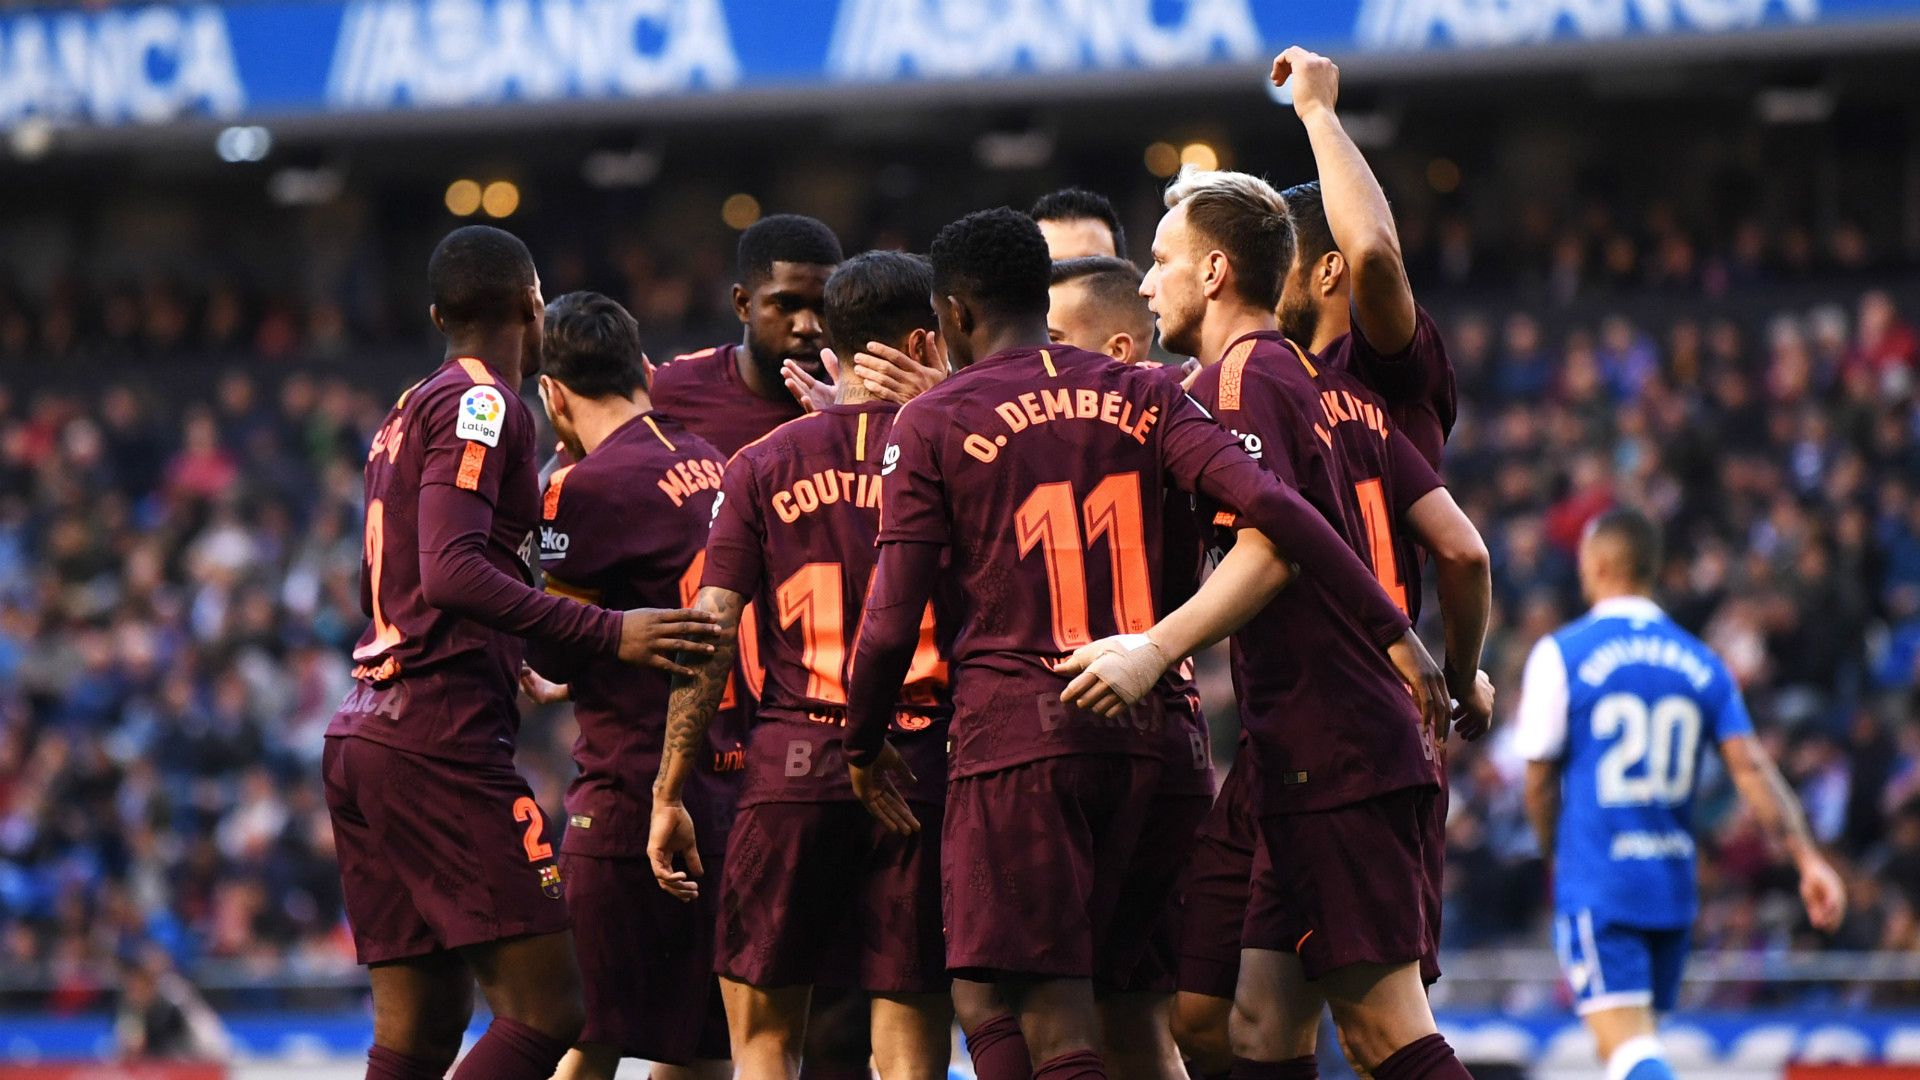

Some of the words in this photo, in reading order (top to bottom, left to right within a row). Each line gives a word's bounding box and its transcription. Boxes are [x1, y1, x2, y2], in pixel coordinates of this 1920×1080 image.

[462, 421, 496, 438] LaLiga
[963, 433, 1008, 464] O.
[994, 388, 1160, 446] DEMBÉLÉ
[1014, 471, 1156, 653] 11
[1590, 693, 1701, 810] 20
[513, 796, 553, 862] 2
